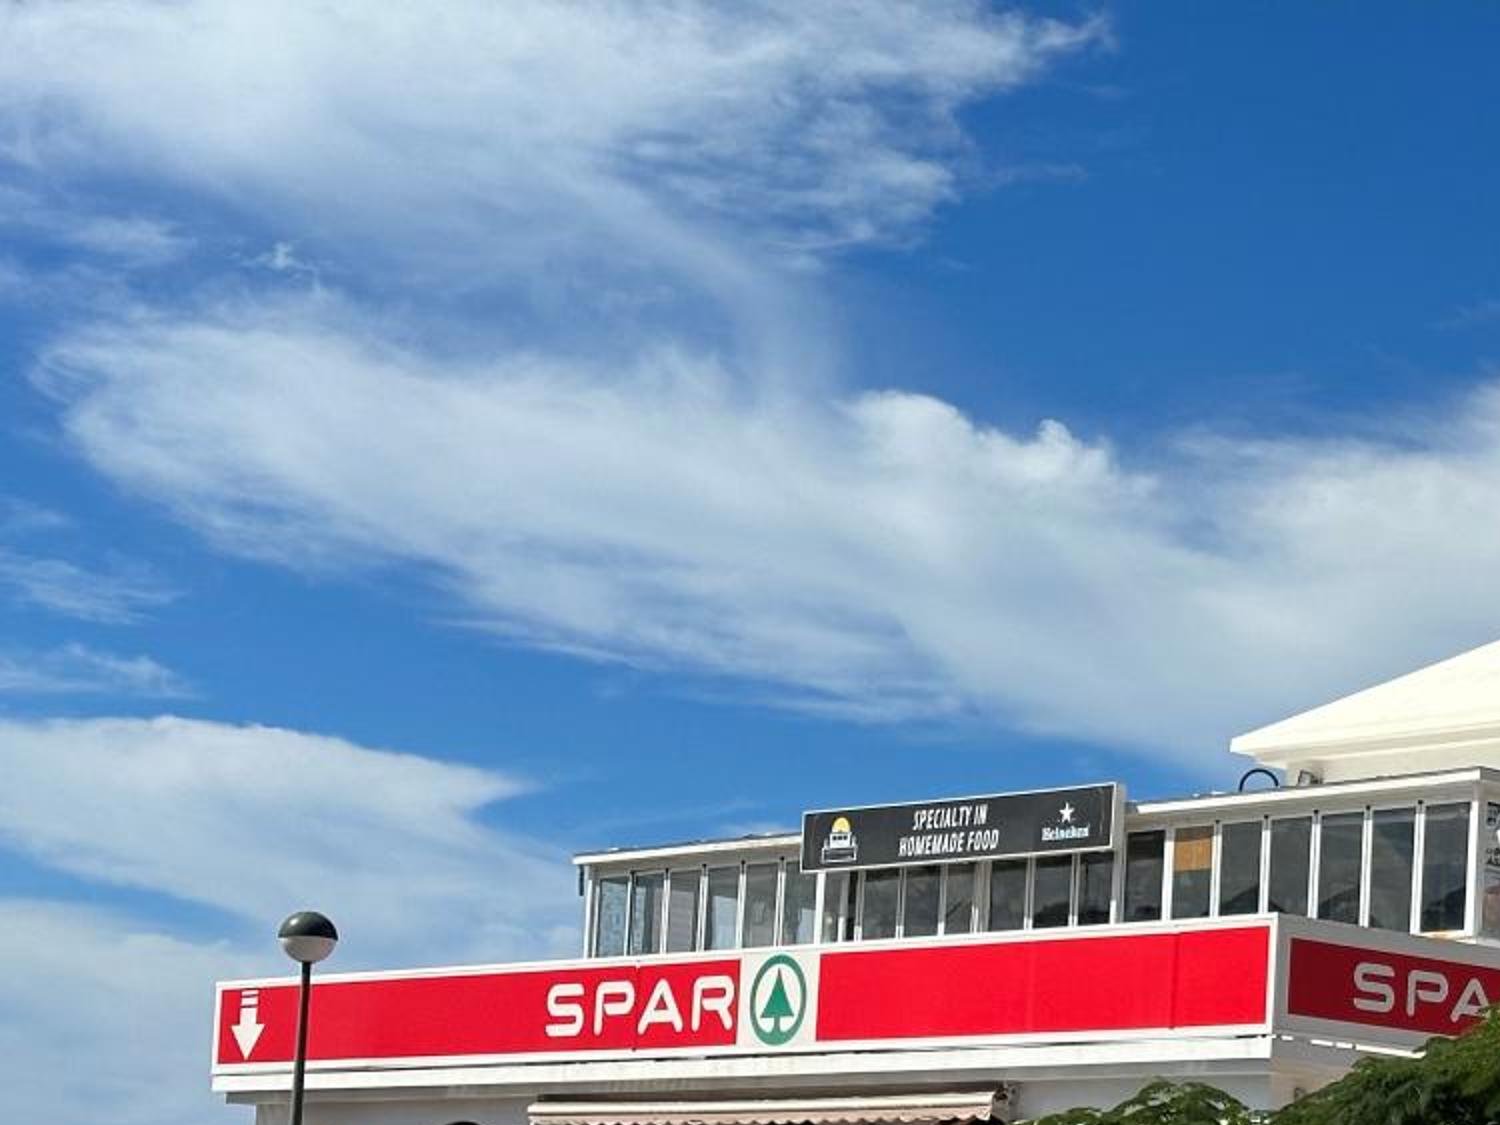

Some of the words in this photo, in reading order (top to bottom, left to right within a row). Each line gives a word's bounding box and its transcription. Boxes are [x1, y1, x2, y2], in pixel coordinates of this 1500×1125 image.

[912, 805, 972, 830] SPECIALTY
[974, 804, 988, 823] IN
[899, 832, 965, 857] HOMEMADE
[967, 829, 999, 851] FOOD
[1041, 824, 1090, 841] Heineken
[545, 975, 736, 1038] SPAR
